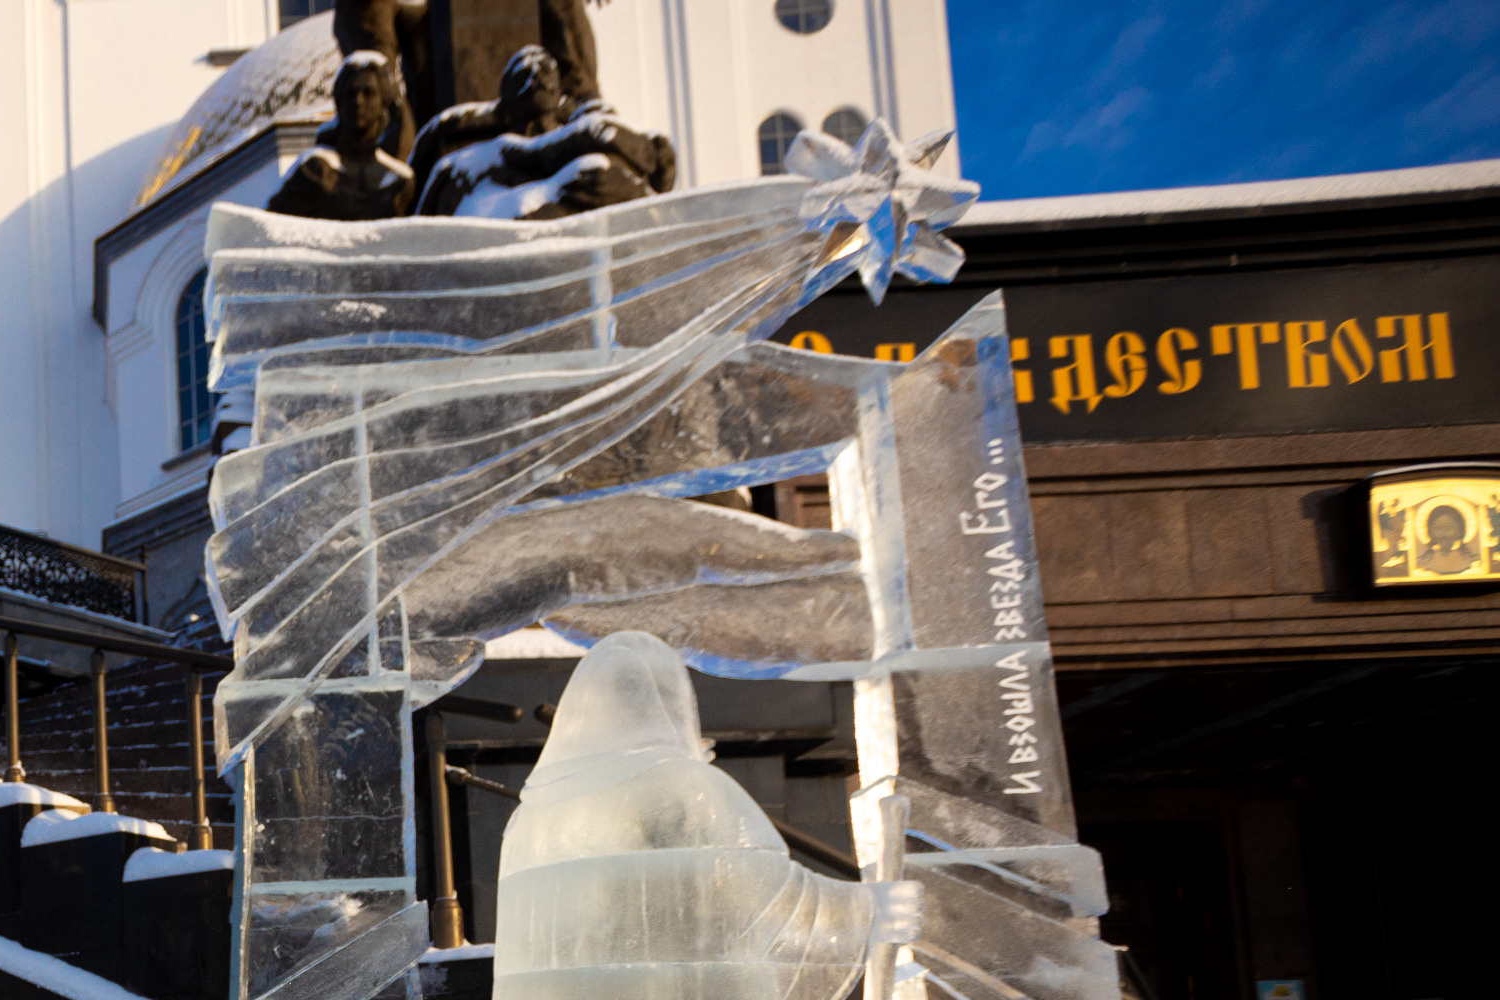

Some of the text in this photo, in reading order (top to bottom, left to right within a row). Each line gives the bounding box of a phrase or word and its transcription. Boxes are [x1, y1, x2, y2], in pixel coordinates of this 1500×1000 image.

[984, 539, 1028, 641] ЗВЕЗДА
[995, 649, 1039, 765] ВЗОШЛА
[1003, 770, 1043, 795] И
